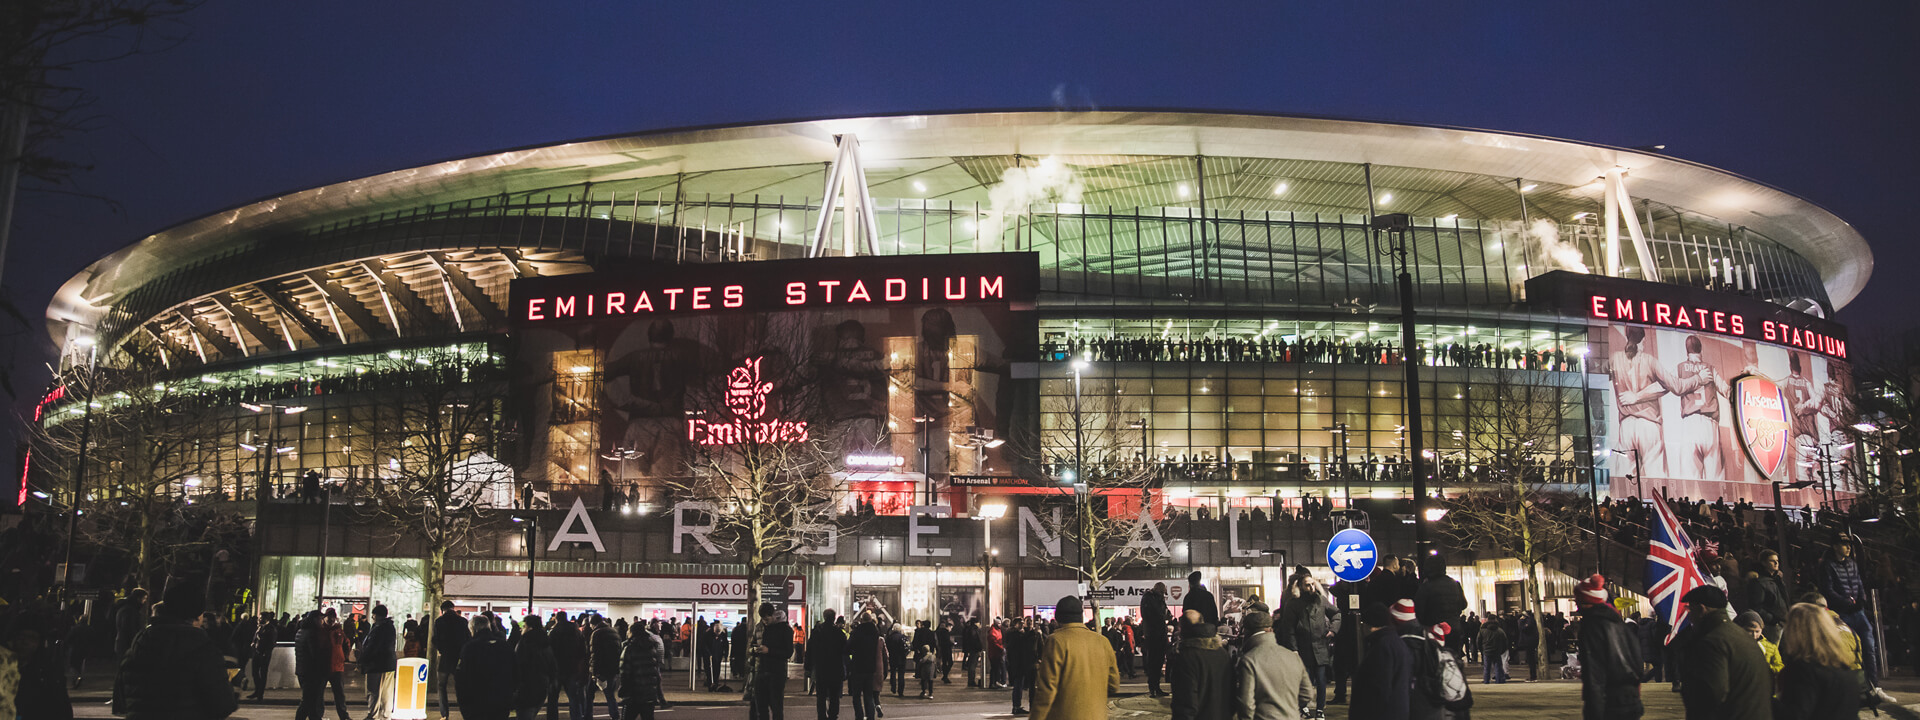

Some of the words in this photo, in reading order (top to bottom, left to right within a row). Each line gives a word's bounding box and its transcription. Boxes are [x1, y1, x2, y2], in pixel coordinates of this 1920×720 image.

[528, 285, 744, 320] EMIRATES
[786, 276, 1004, 305] STADIUM
[1591, 295, 1745, 335] EMIRATES
[1763, 320, 1847, 358] STADIUM
[1684, 363, 1706, 373] DRA
[1744, 391, 1781, 410] Arsenal
[966, 477, 991, 485] Arsenal
[547, 496, 1261, 558] ARSENAL
[1337, 518, 1365, 527] Arnal
[701, 583, 729, 595] BOX
[1105, 586, 1125, 596] The
